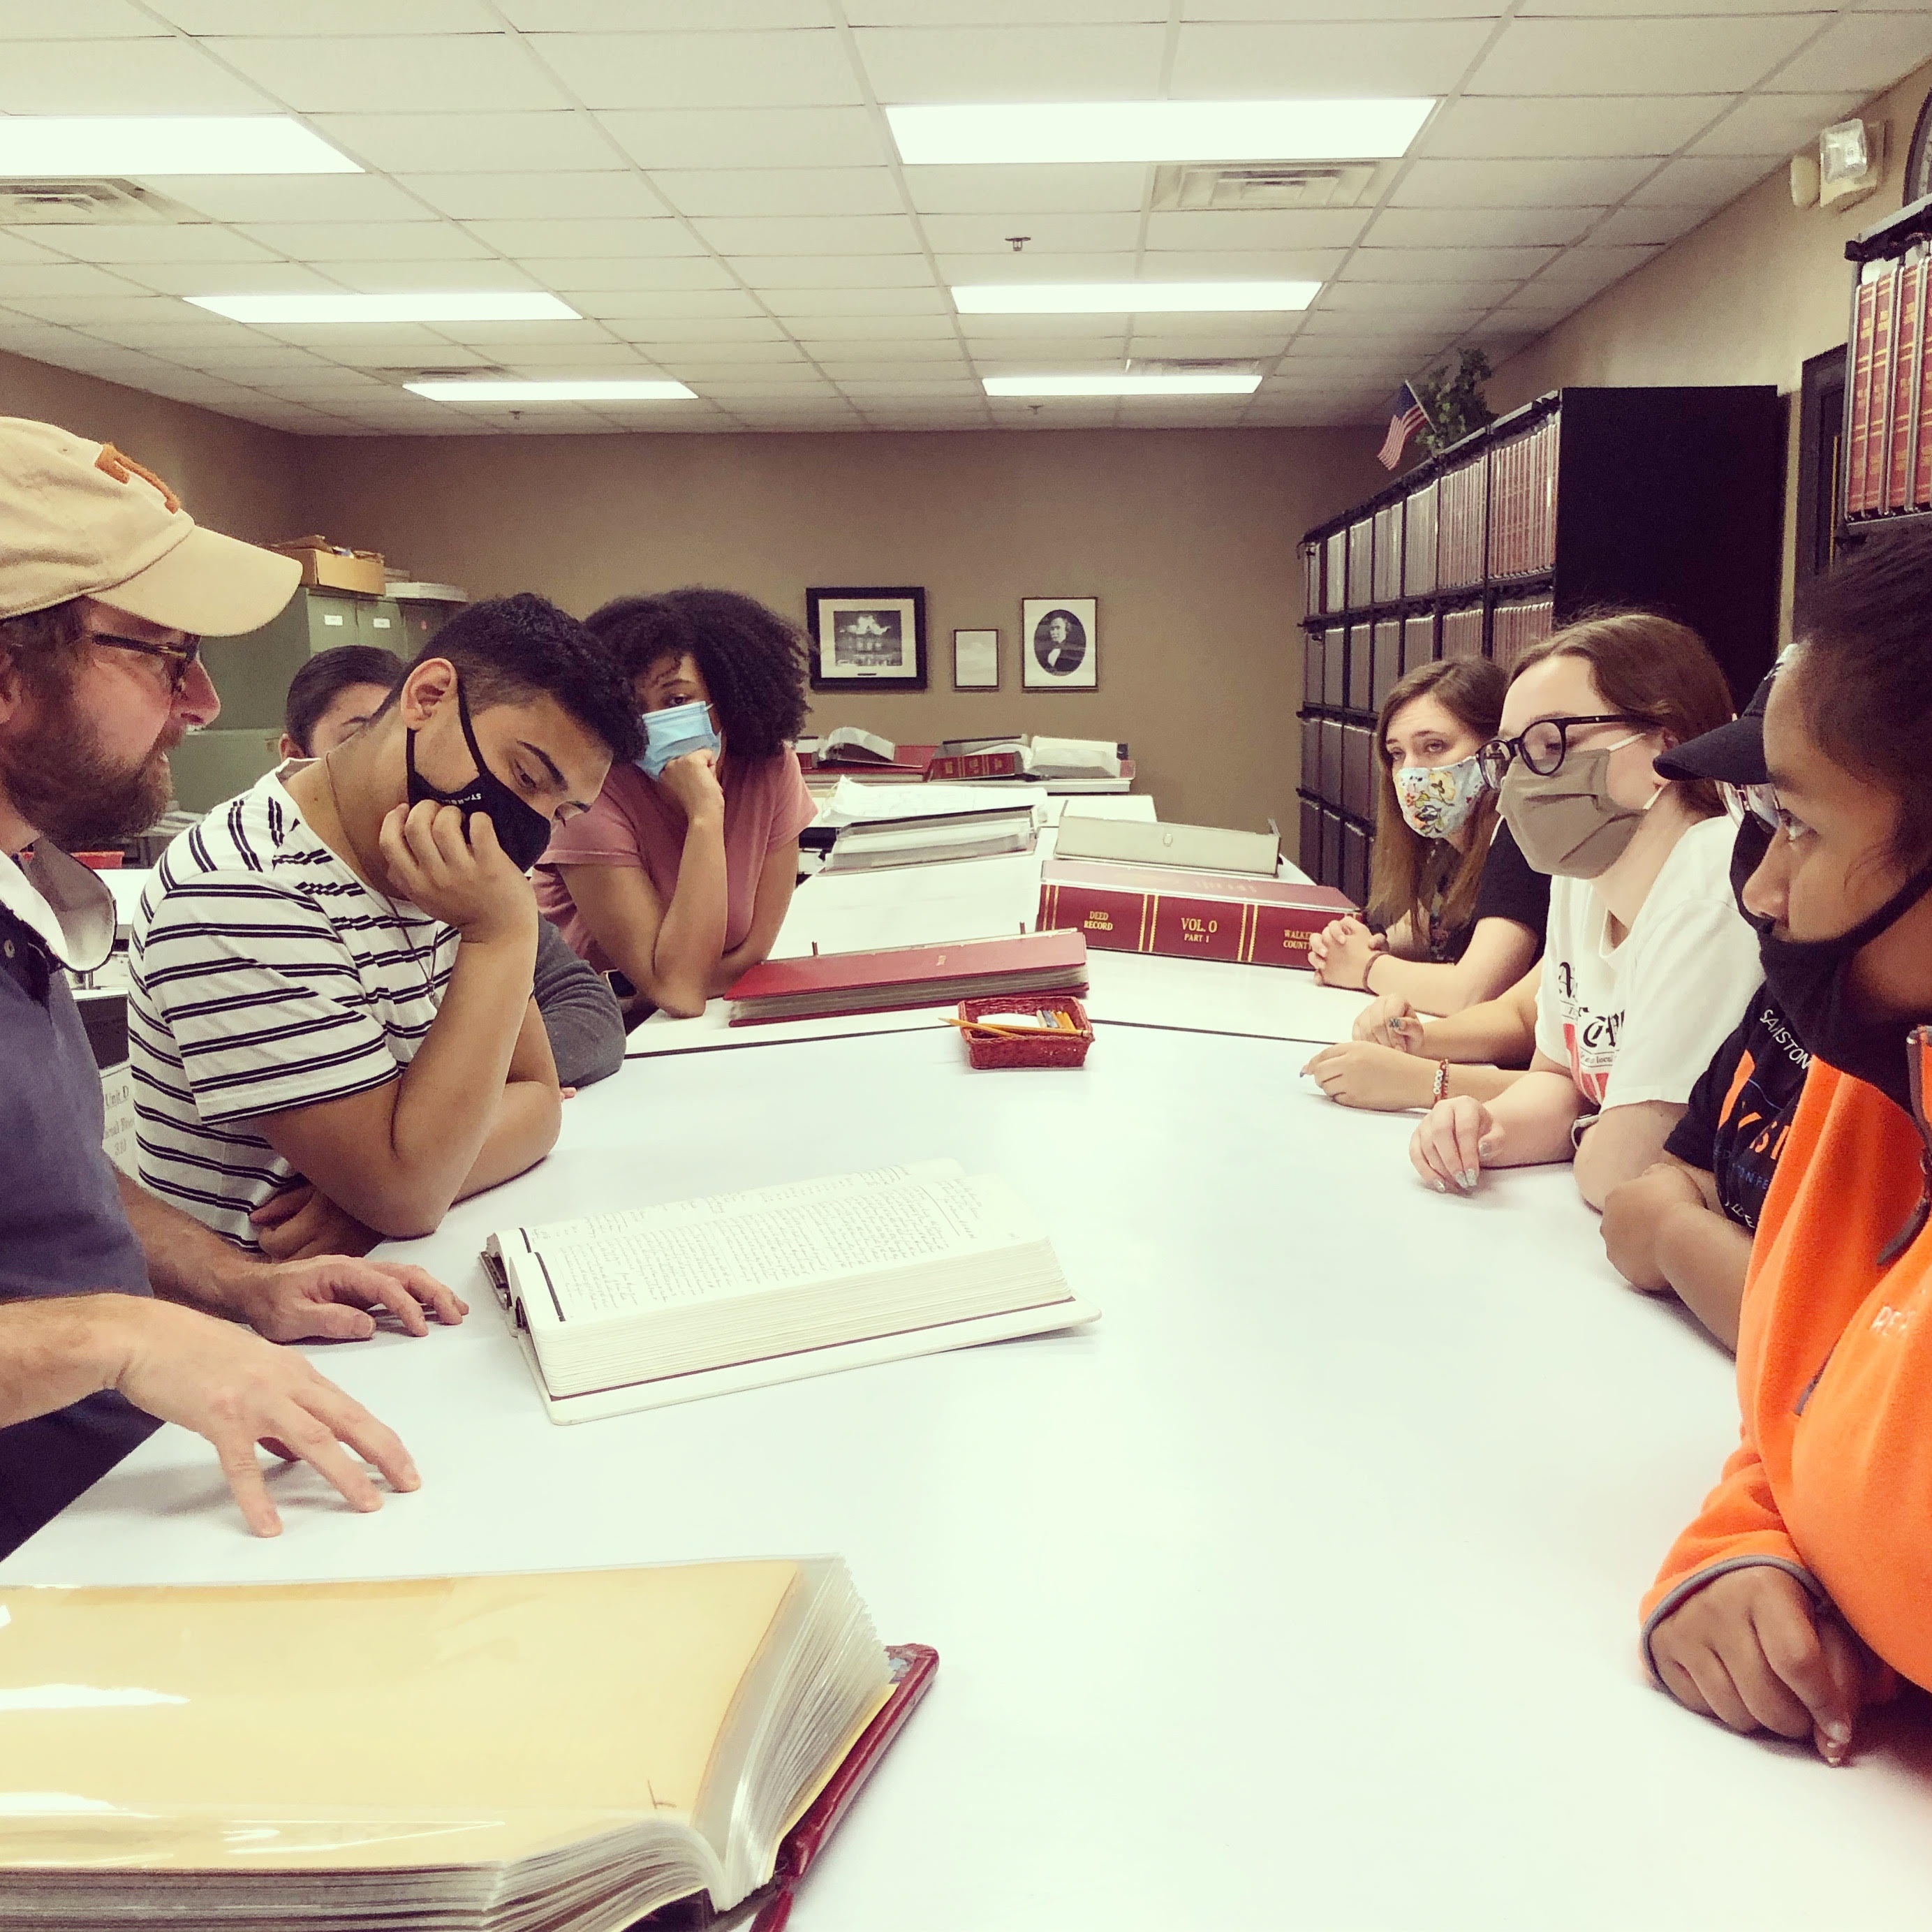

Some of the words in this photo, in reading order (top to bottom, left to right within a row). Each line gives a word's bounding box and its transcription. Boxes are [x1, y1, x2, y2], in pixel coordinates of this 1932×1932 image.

[1089, 910, 1109, 920] DEED
[1084, 920, 1114, 931] RECORD
[1181, 917, 1207, 932] VOL.
[1184, 933, 1203, 943] PART
[1284, 929, 1312, 940] WALKE
